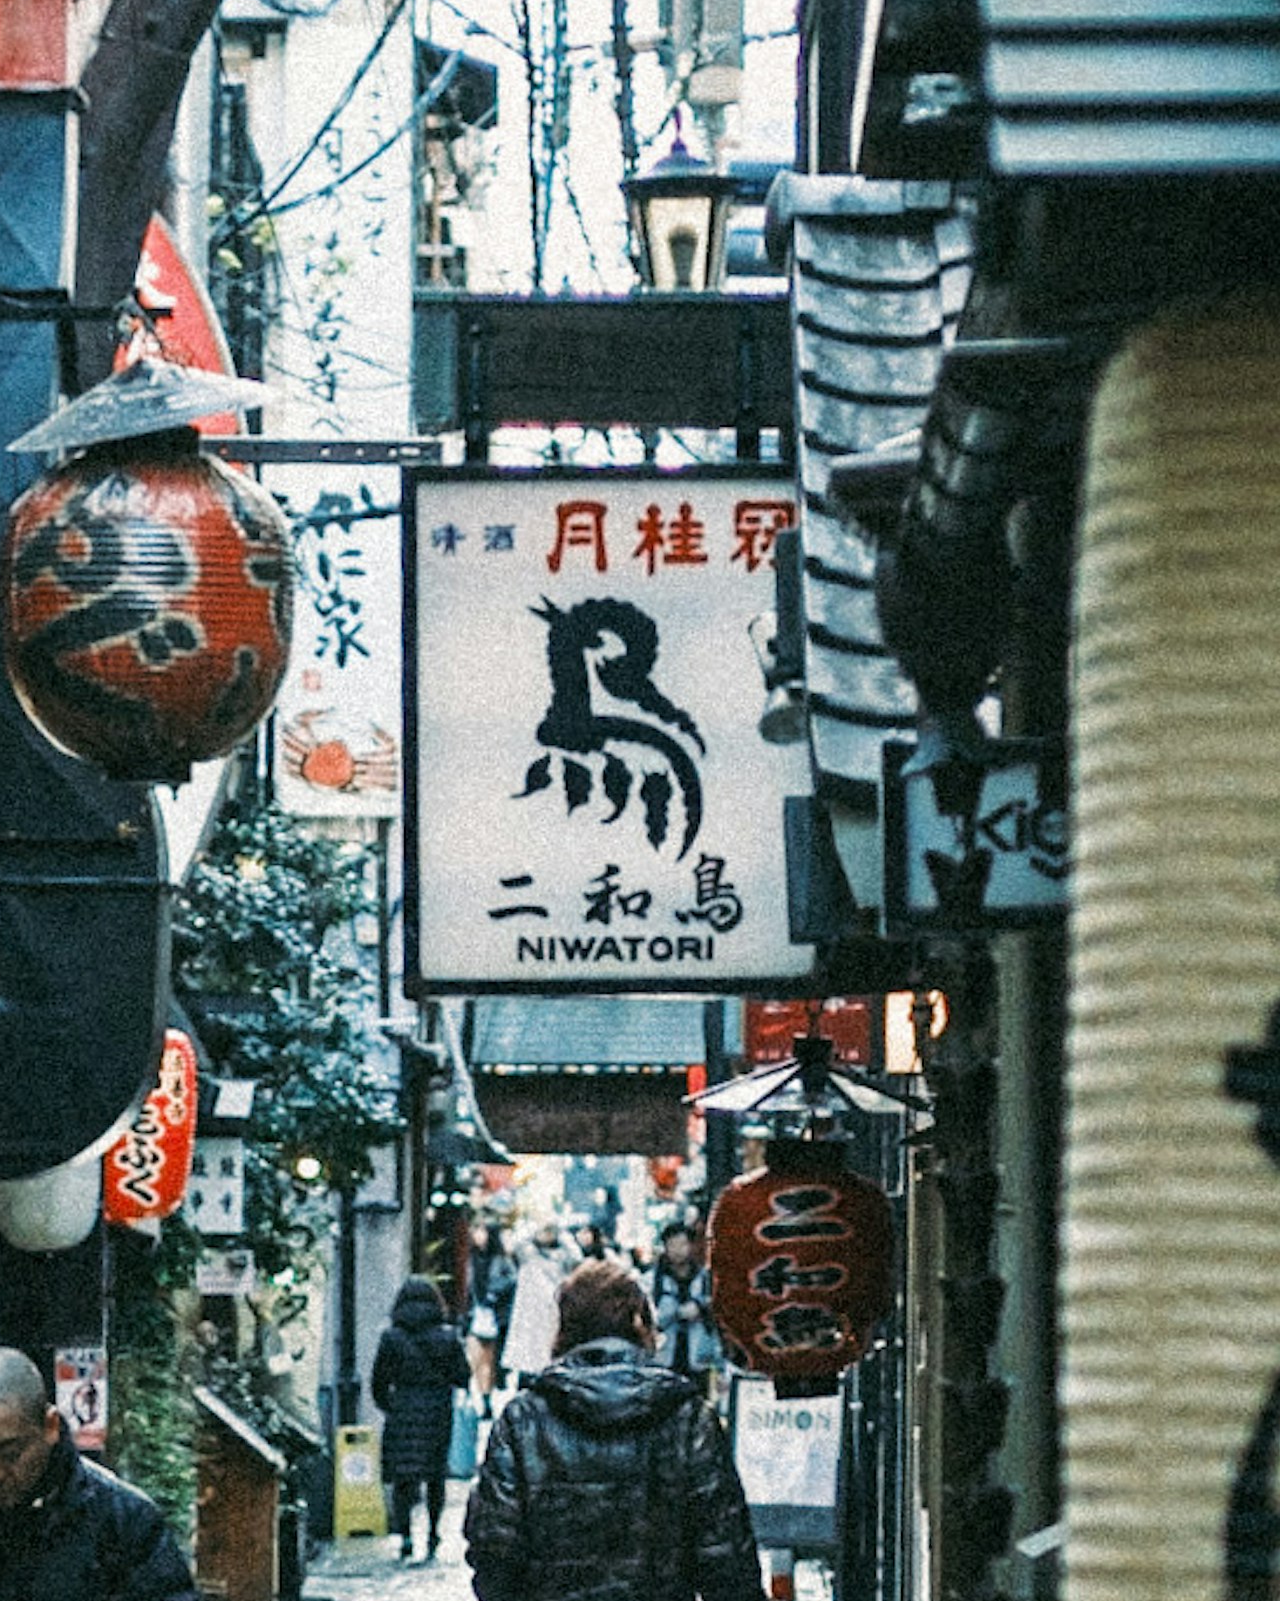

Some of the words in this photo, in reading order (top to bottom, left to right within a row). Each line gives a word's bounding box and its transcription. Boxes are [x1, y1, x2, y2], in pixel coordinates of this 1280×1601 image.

[489, 855, 744, 932] 二和鳥
[517, 934, 715, 962] NIWATORI
